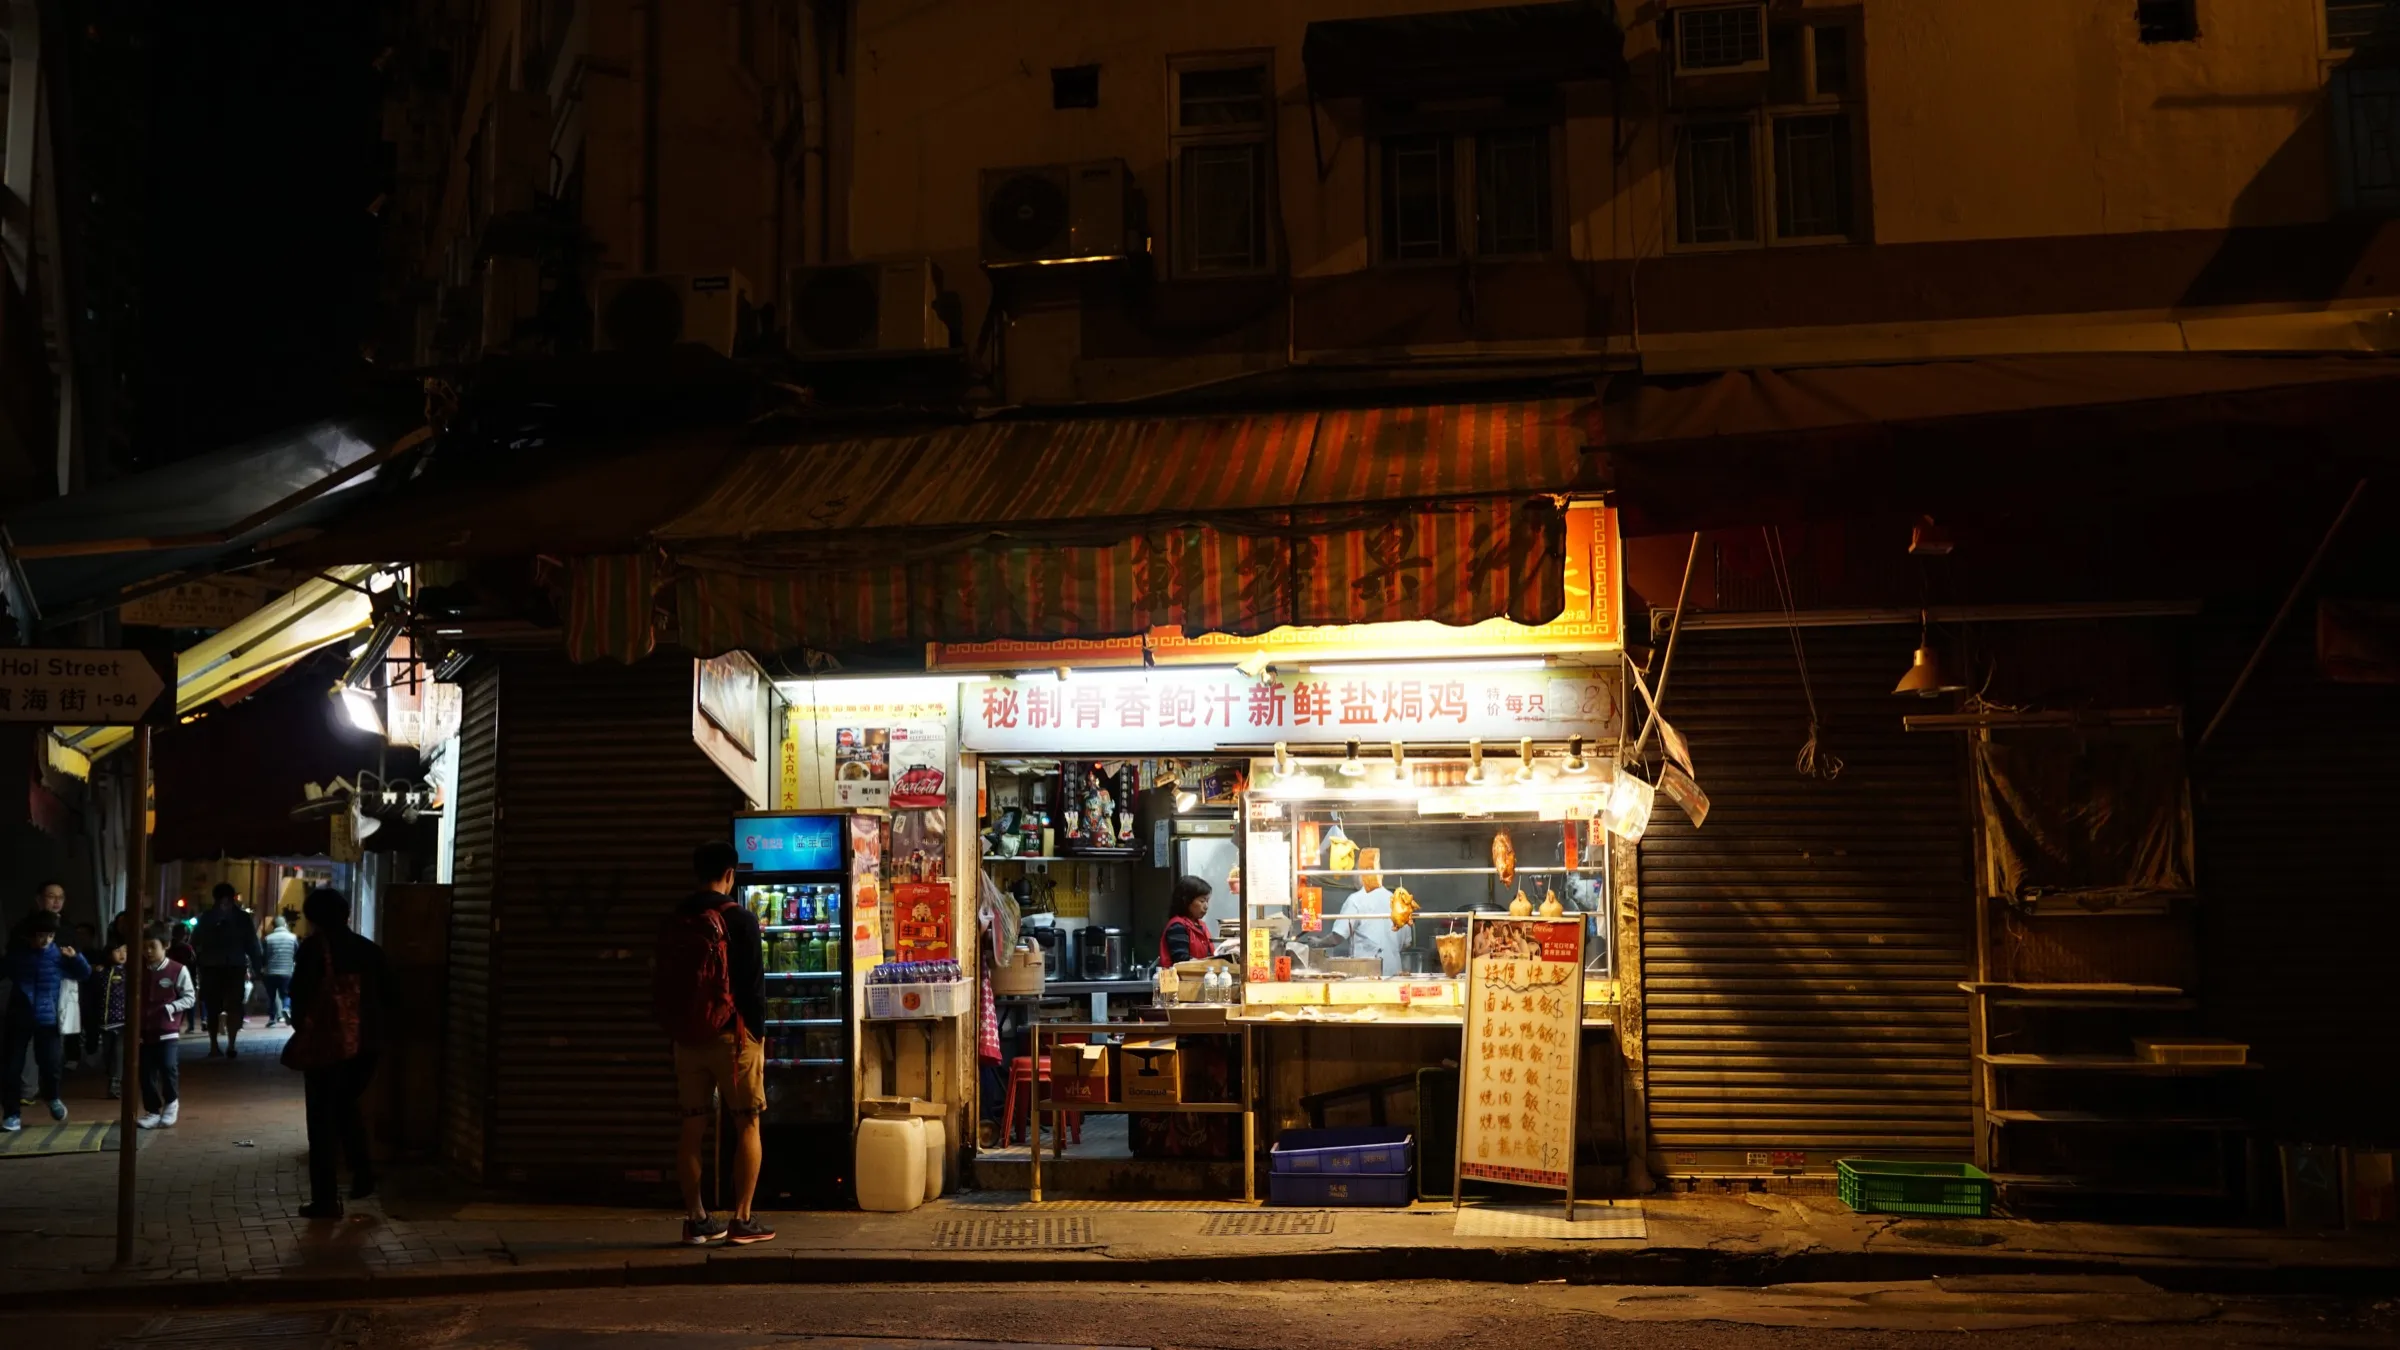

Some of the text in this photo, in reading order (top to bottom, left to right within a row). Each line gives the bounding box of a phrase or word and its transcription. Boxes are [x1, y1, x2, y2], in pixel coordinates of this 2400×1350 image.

[2, 658, 121, 676] Hoi Street
[97, 693, 137, 708] 1-94
[982, 680, 1469, 729] 秘制骨香鲍汁新鲜盐焗鸡
[1486, 686, 1500, 717] 特价
[1504, 693, 1545, 714] 每只
[784, 742, 795, 775] 特大只
[1128, 1086, 1167, 1098] Bonaqua
